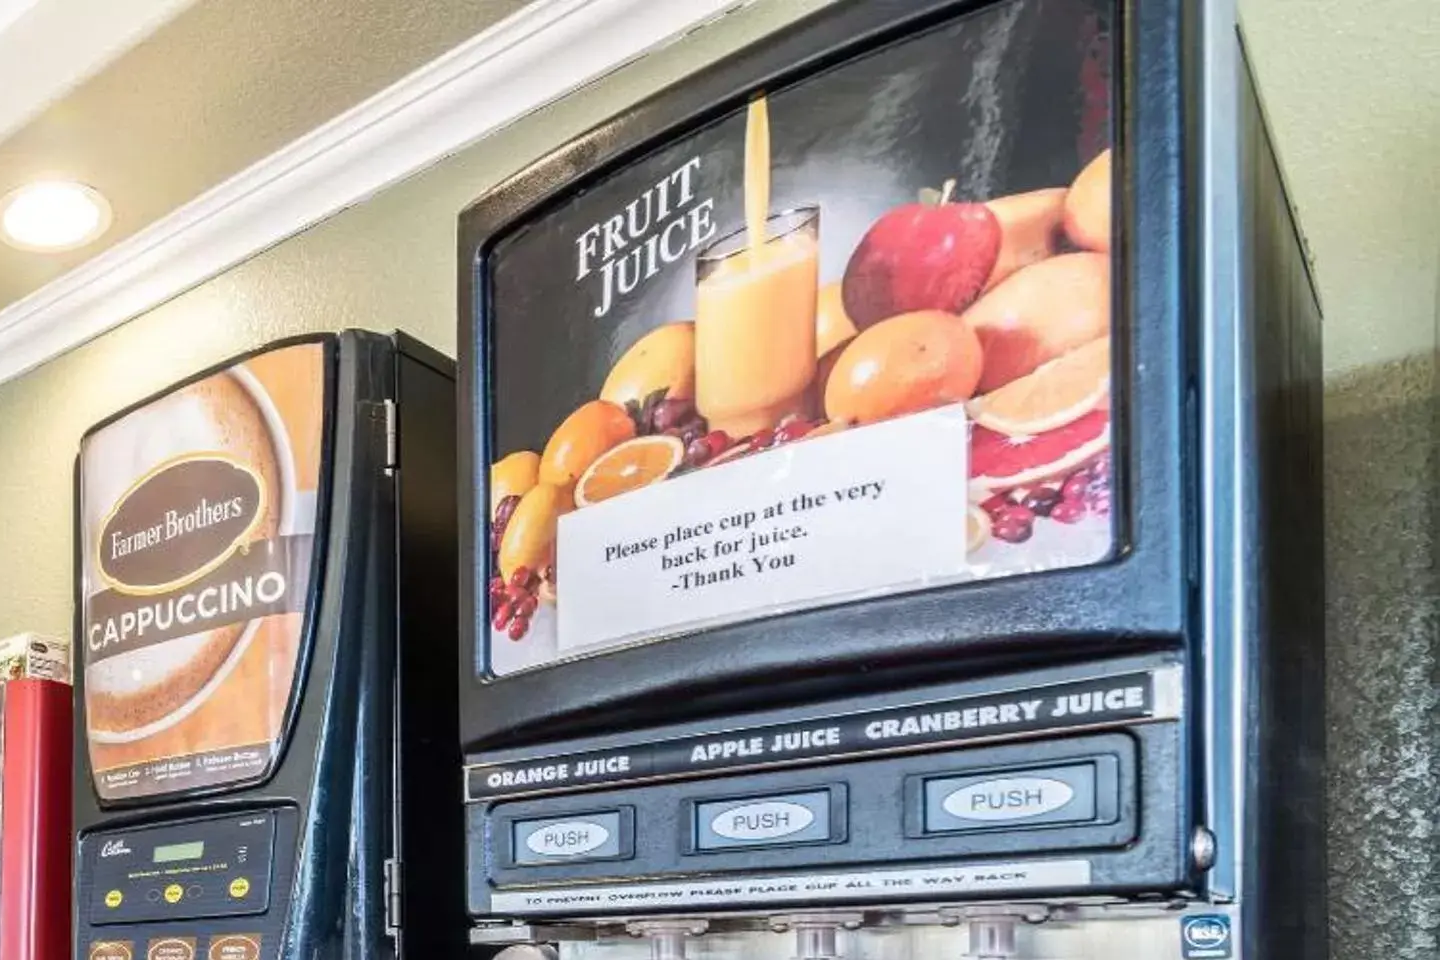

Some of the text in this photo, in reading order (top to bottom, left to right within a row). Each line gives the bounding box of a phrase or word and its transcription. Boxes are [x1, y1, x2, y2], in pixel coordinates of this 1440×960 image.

[575, 154, 702, 282] FRUIT
[594, 197, 717, 318] JUICE
[110, 496, 243, 561] Farmer Brothers
[604, 479, 886, 562] Please place cup at the very
[661, 524, 809, 571] back for juice.
[671, 553, 796, 591] -Thank You
[88, 571, 286, 651] CAPPUCCINO
[864, 686, 1145, 740] CRANBERRY JUICE
[690, 726, 841, 764] APPLE JUICE
[486, 755, 631, 788] ORANGE JUICE
[970, 788, 1043, 811] PUSH
[544, 830, 590, 848] PUSH
[732, 811, 790, 832] PUSH
[525, 897, 543, 906] TO
[747, 884, 798, 894] PLACE
[844, 880, 873, 889] ALL
[882, 877, 911, 887] THE
[922, 874, 965, 885] WAY
[973, 871, 1028, 882] BACK
